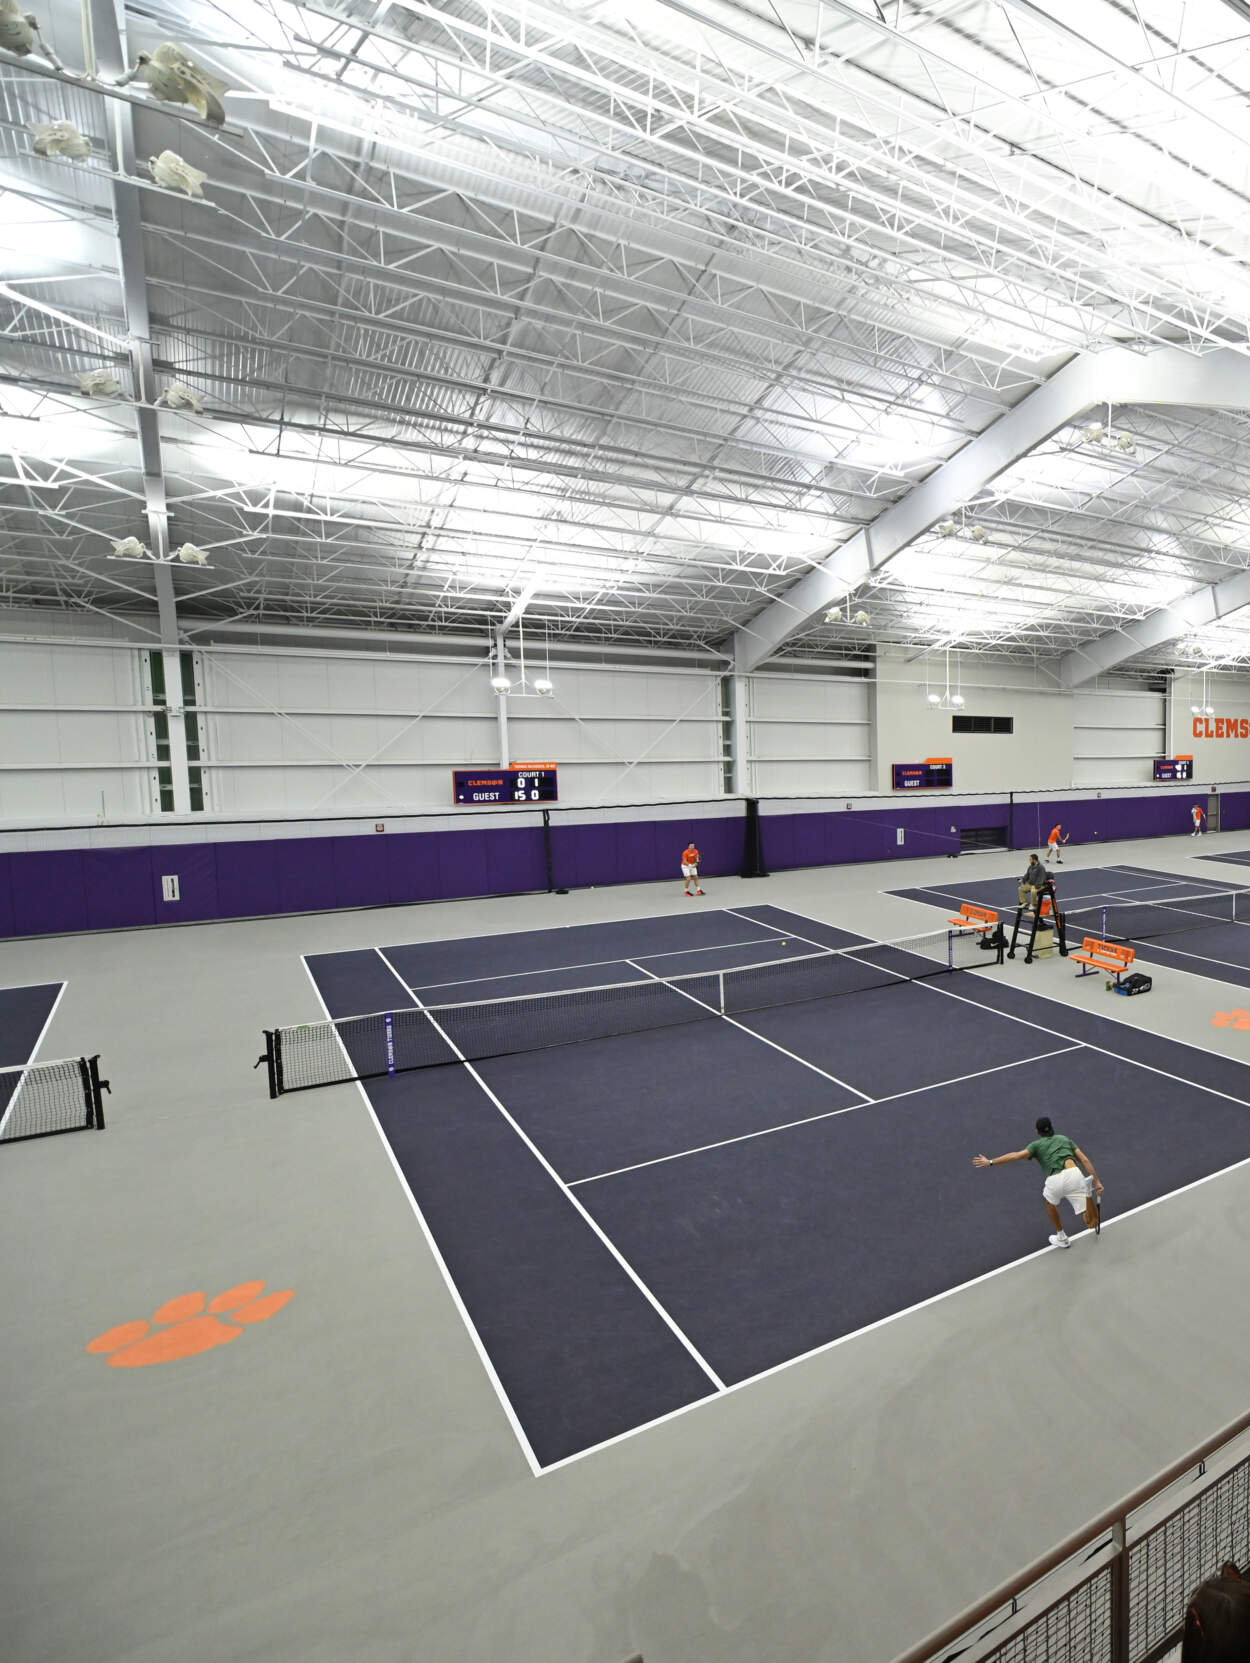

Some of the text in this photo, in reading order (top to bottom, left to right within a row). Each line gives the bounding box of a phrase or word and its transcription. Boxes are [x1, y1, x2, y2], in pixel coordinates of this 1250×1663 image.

[517, 778, 526, 788] 0
[534, 778, 539, 787] 1
[473, 790, 539, 800] GUEST 15 0
